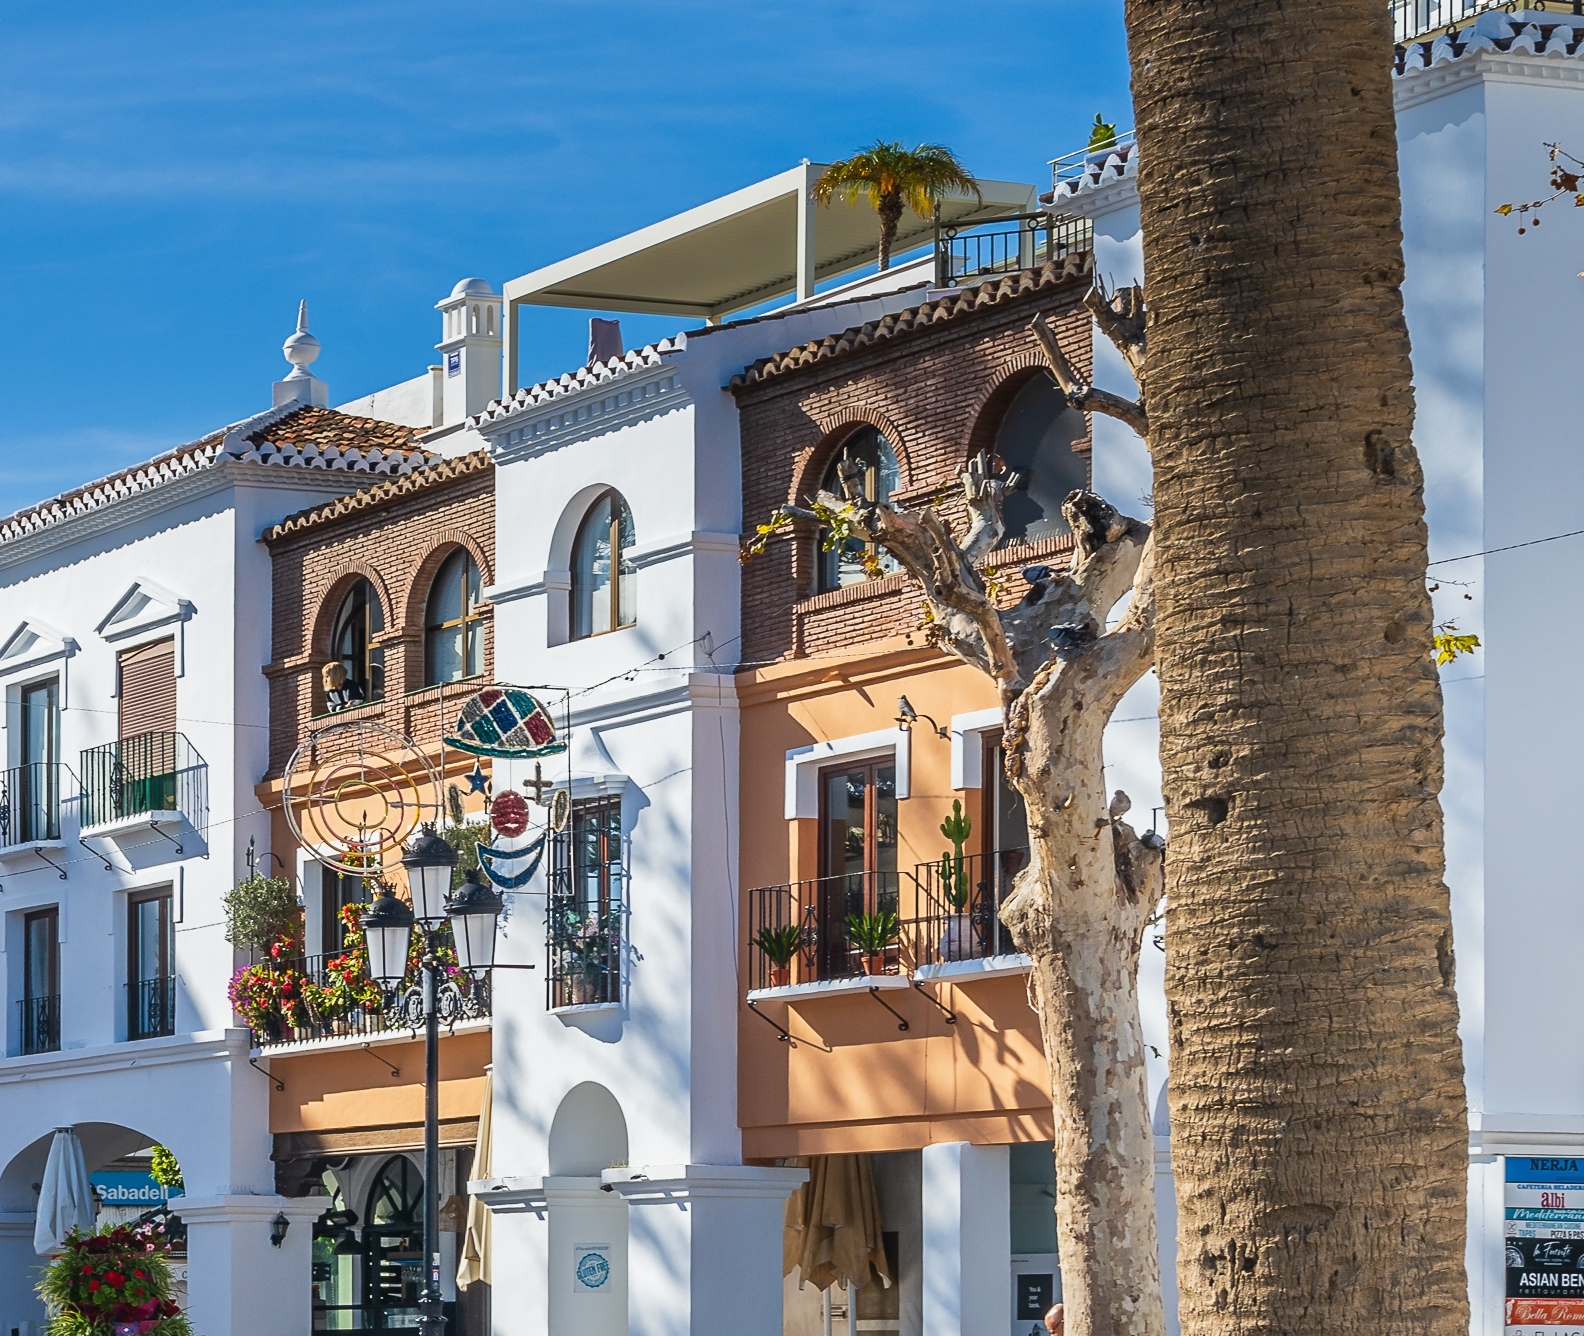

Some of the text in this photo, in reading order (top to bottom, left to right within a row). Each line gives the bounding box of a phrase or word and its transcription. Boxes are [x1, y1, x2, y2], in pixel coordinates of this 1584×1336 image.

[1530, 1158, 1579, 1172] NERJA
[96, 1184, 169, 1200] Sabadell
[1541, 1192, 1565, 1208] albi
[1544, 1241, 1573, 1258] Fuente
[1520, 1273, 1559, 1286] ASIAN
[1515, 1304, 1548, 1320] Bella
